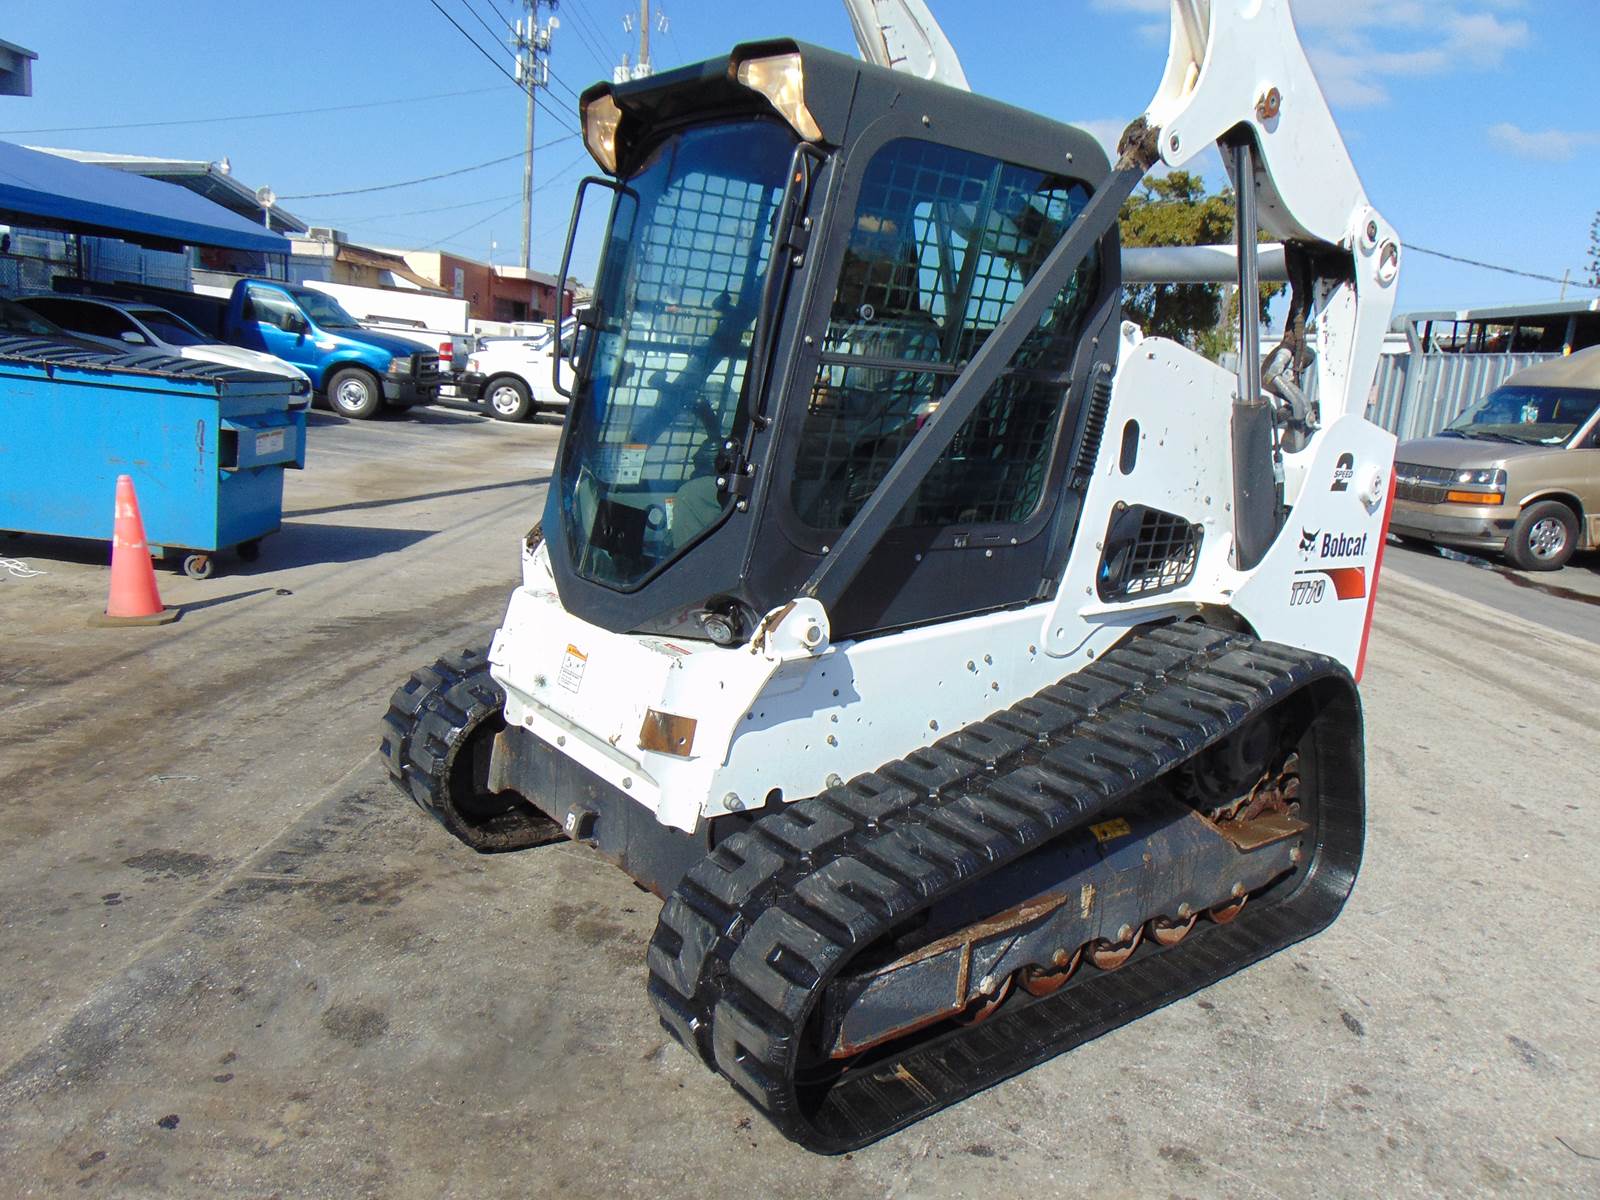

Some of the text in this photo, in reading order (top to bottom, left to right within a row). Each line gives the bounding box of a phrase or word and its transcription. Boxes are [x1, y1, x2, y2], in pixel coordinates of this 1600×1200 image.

[1330, 452, 1354, 492] 2
[1333, 470, 1354, 478] SPEED
[1321, 532, 1367, 558] Bobcat
[1290, 579, 1326, 606] T770
